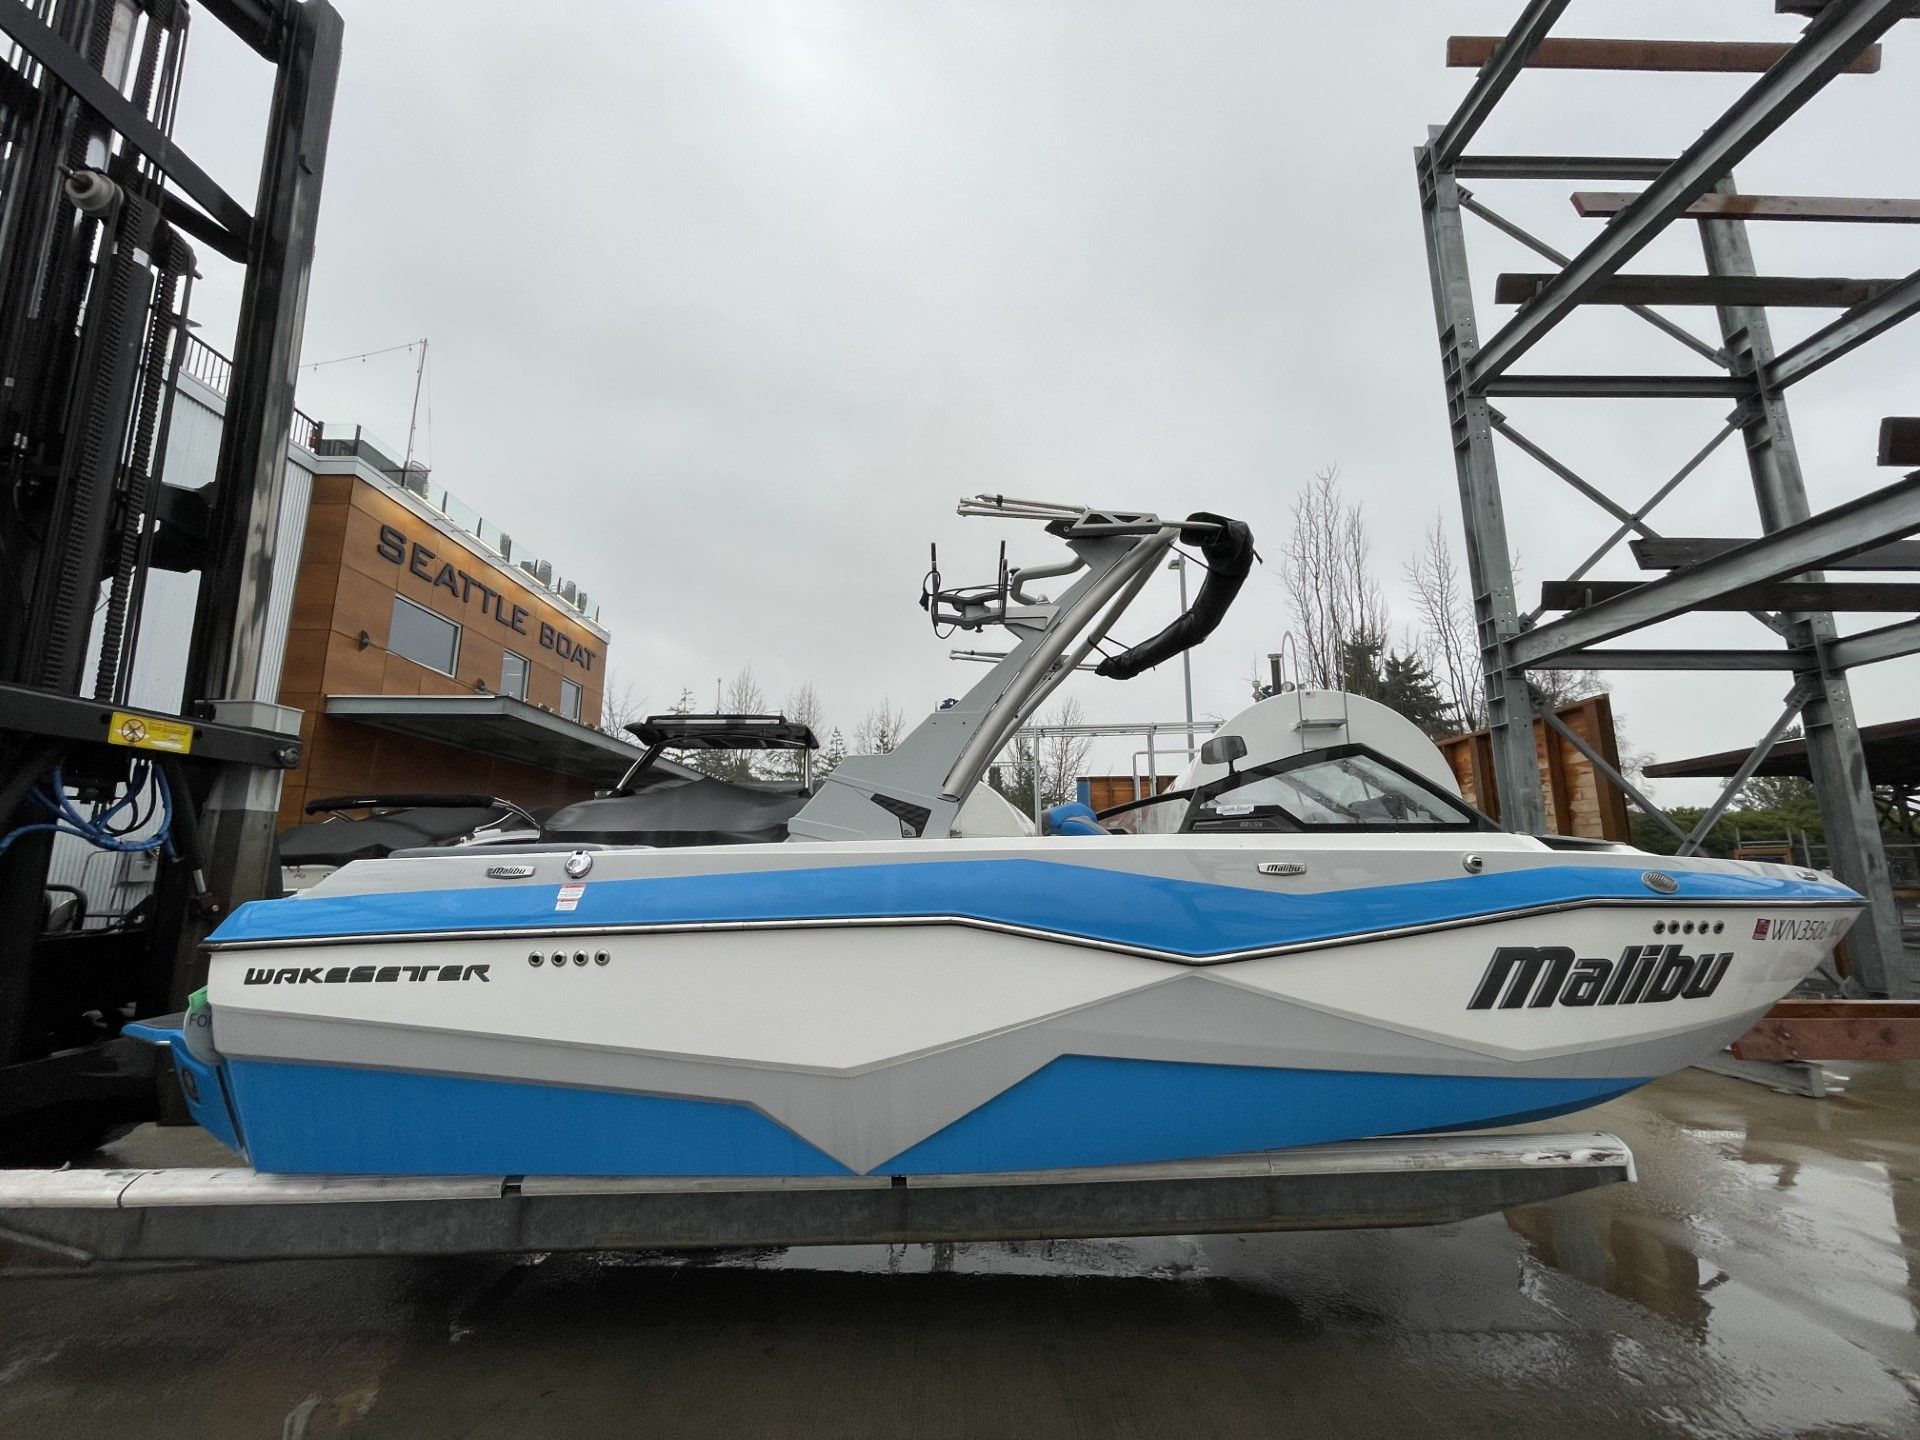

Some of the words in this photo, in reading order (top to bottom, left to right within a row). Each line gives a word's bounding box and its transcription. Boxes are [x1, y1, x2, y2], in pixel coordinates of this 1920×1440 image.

[377, 524, 529, 635] SEATTLE
[539, 622, 596, 671] BOAT
[491, 866, 526, 875] Malibu
[1266, 864, 1300, 872] Malibu
[243, 964, 490, 985] WAKESETTER
[1466, 944, 1735, 1010] Malibu
